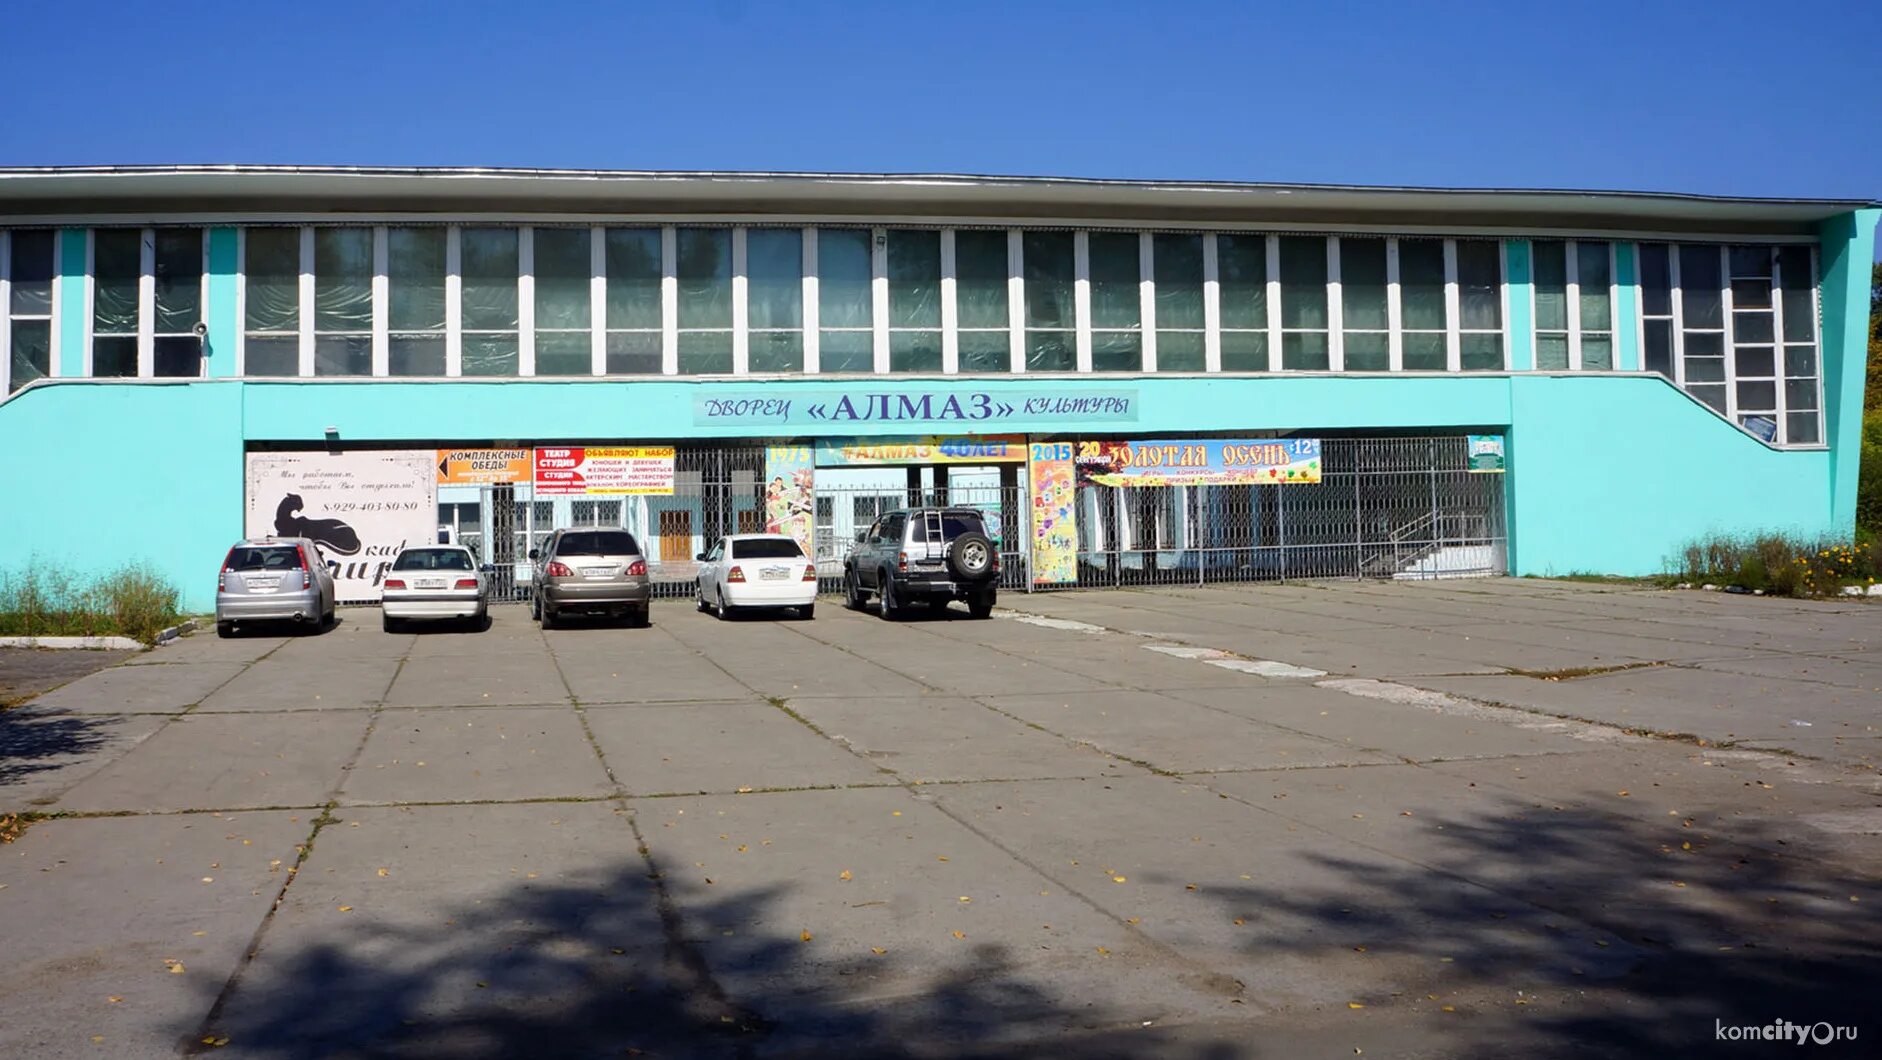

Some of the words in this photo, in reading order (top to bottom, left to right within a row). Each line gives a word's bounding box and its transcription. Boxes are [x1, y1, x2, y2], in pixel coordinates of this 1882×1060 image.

[704, 398, 792, 423] ДВОРЕЦ
[807, 393, 1014, 420] «АЛМАЗ»
[1023, 396, 1129, 415] КУЛЬТУРЫ
[544, 449, 571, 458] ТЕАТР
[645, 448, 673, 456] НАБОР
[1032, 444, 1071, 462] 2015
[1080, 441, 1100, 457] 20
[1294, 439, 1312, 454] 12
[449, 450, 526, 460] КОМПЛЕКСНЫЕ
[769, 446, 810, 463] 1975
[1108, 445, 1208, 468] ЗОЛОТАЯ
[1222, 445, 1291, 466] ОСЕНЬ
[471, 461, 507, 470] ОБЕДЫ
[539, 459, 576, 467] СТУДИЯ
